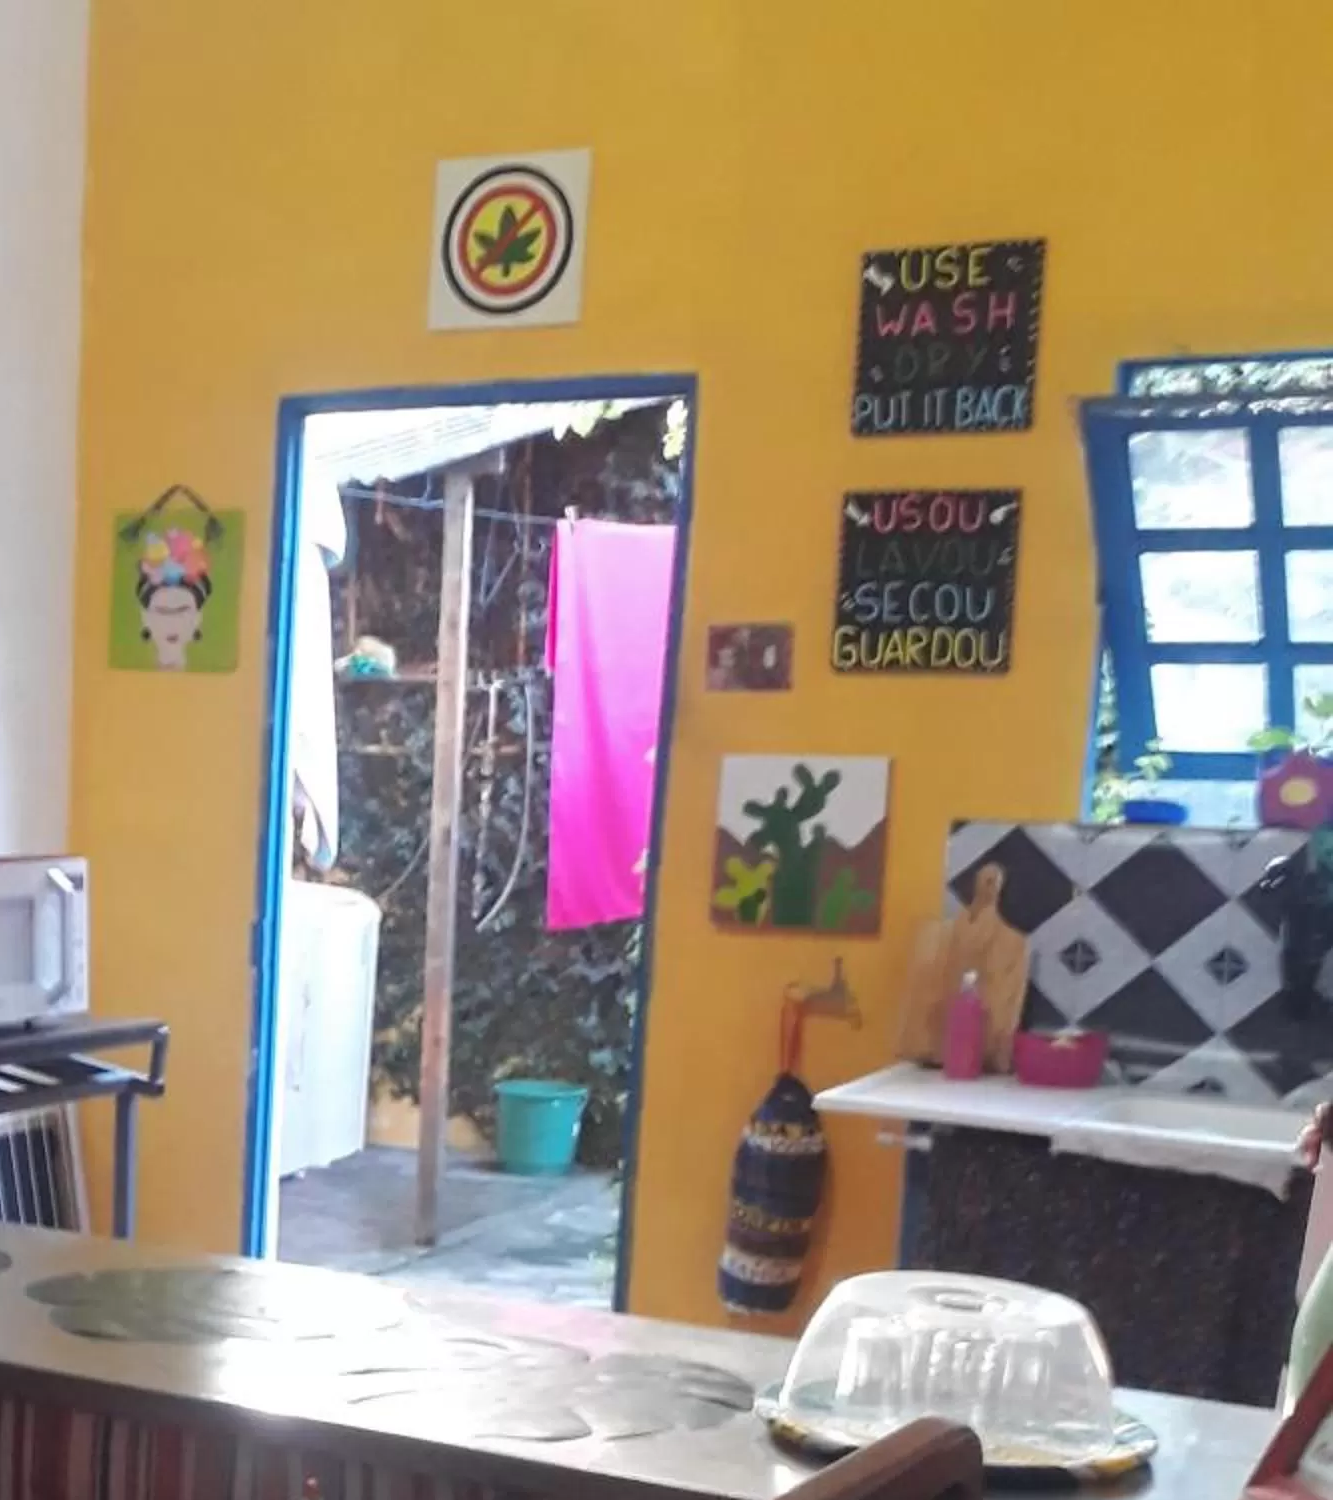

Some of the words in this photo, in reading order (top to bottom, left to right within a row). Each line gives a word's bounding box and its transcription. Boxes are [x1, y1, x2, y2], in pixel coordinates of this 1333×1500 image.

[898, 246, 993, 291] USE
[875, 291, 1017, 338] WASH
[893, 340, 989, 384] DRY
[853, 389, 912, 432] PUT
[922, 387, 952, 430] IT
[954, 383, 1028, 429] BACK
[872, 494, 987, 534] USOU
[854, 536, 998, 578] LAVOU
[853, 580, 995, 625] SECOU
[830, 624, 1006, 673] GUARDOU
